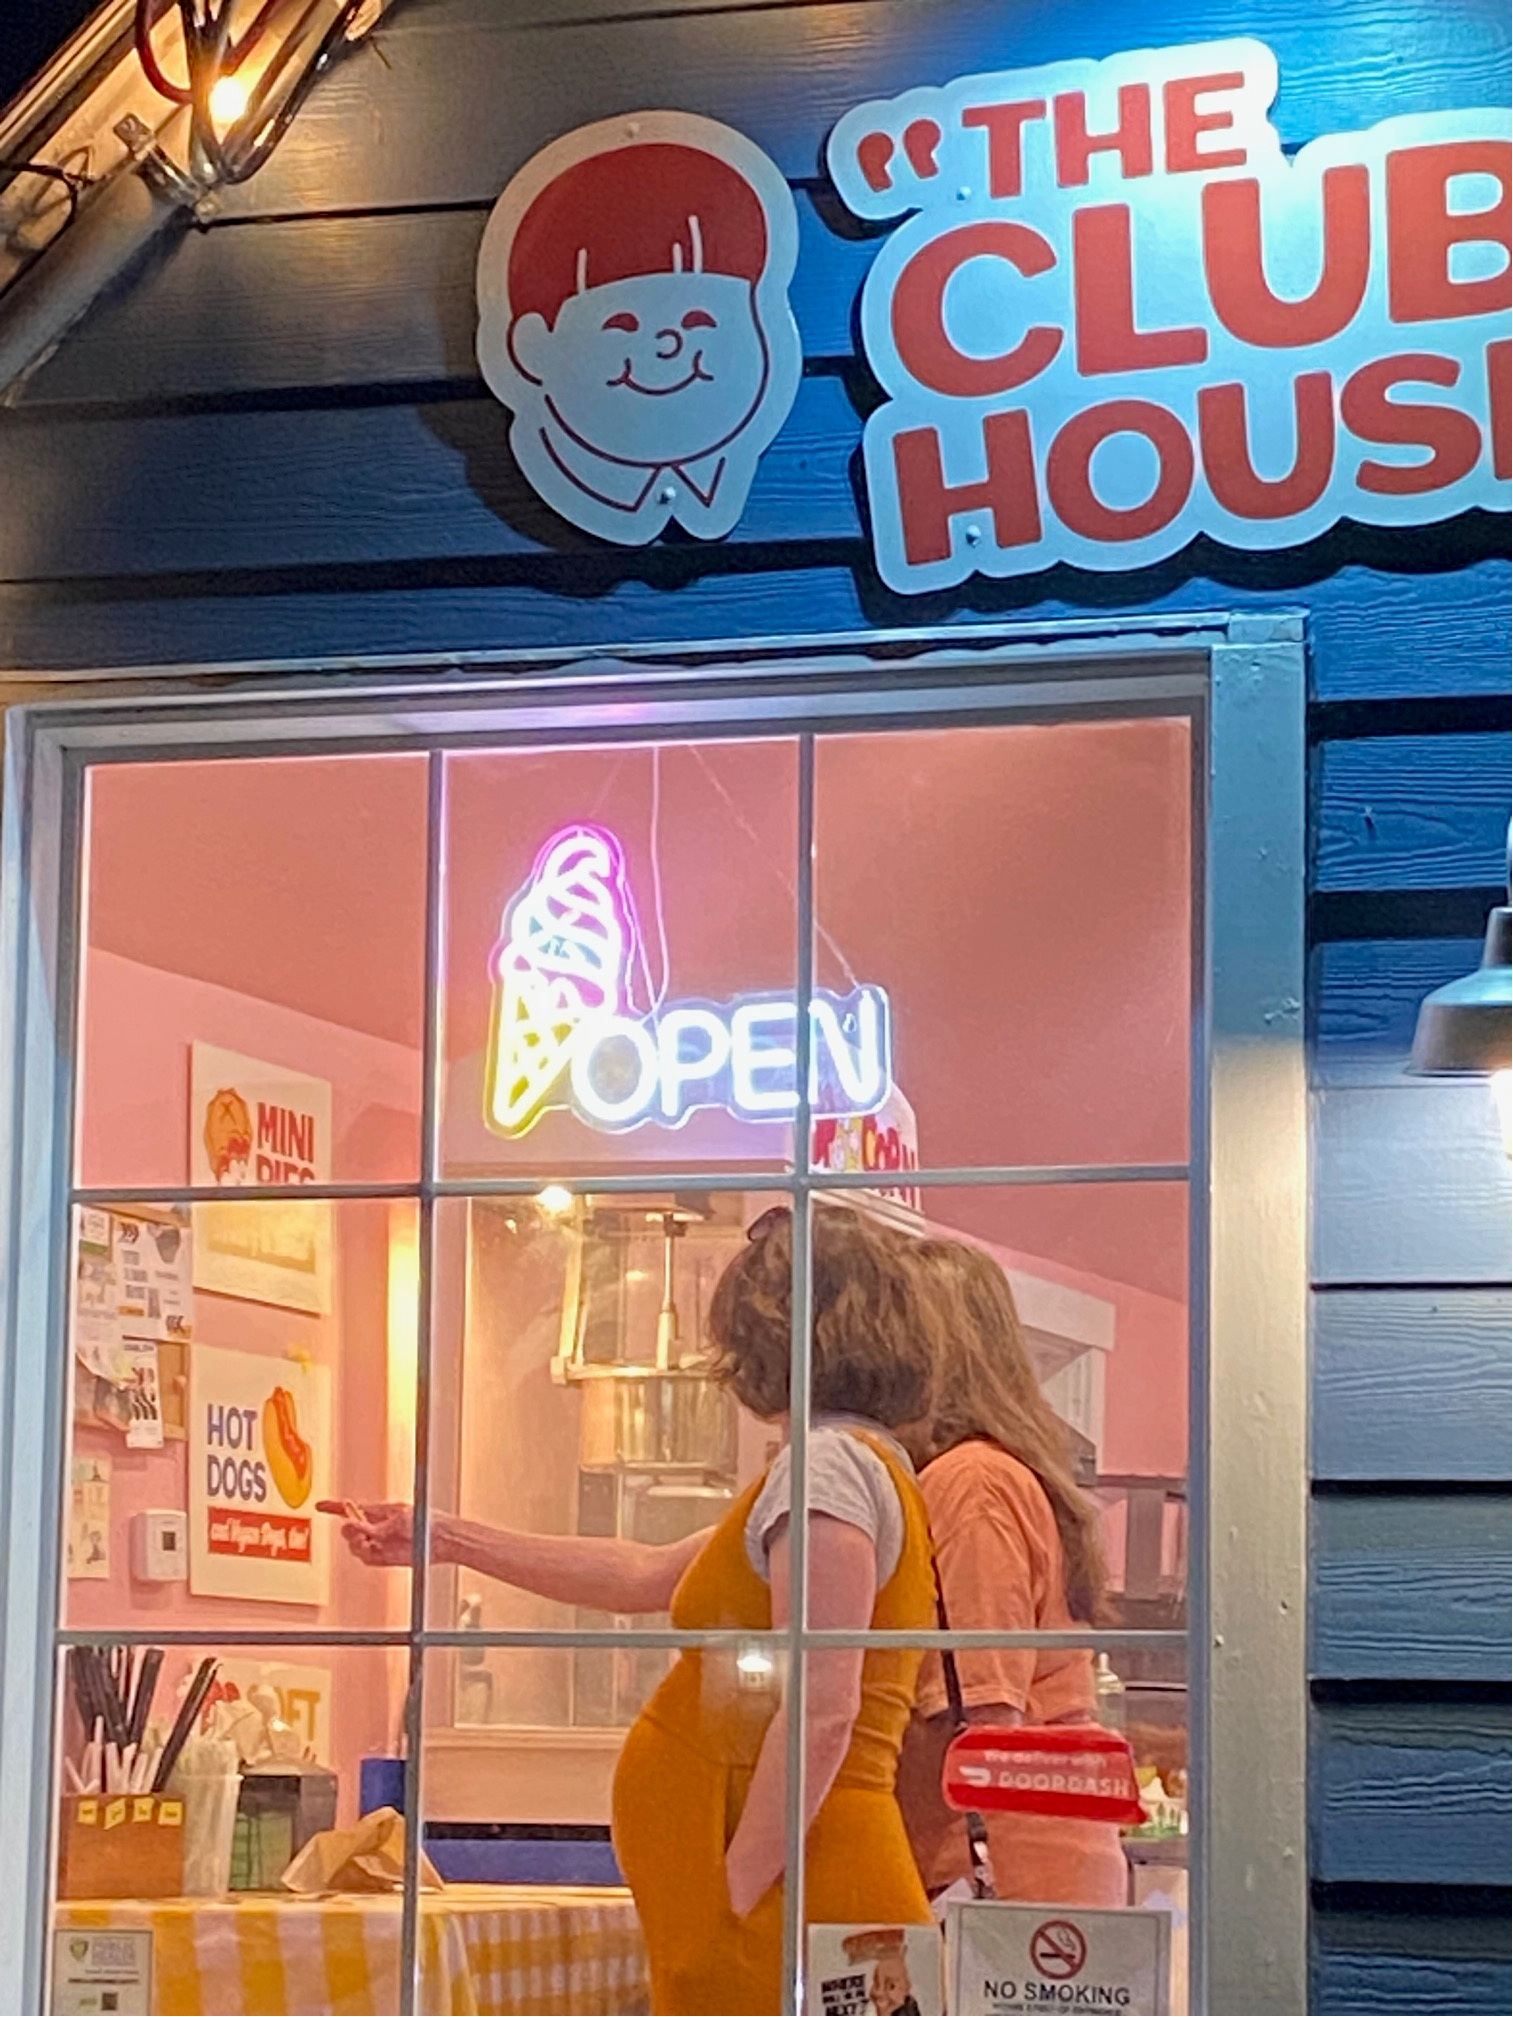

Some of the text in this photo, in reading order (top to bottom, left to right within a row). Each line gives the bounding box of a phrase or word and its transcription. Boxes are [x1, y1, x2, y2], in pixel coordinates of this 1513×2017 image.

[890, 140, 1512, 398] CLUB
[891, 339, 1512, 566] HOUS
[571, 989, 888, 1122] OPEN
[257, 1102, 314, 1164] MINI
[207, 1403, 258, 1451] HOT
[206, 1454, 267, 1502] DOGS
[999, 1771, 1130, 1798] DOORDASH
[984, 1980, 1131, 2006] NO SMOKING
